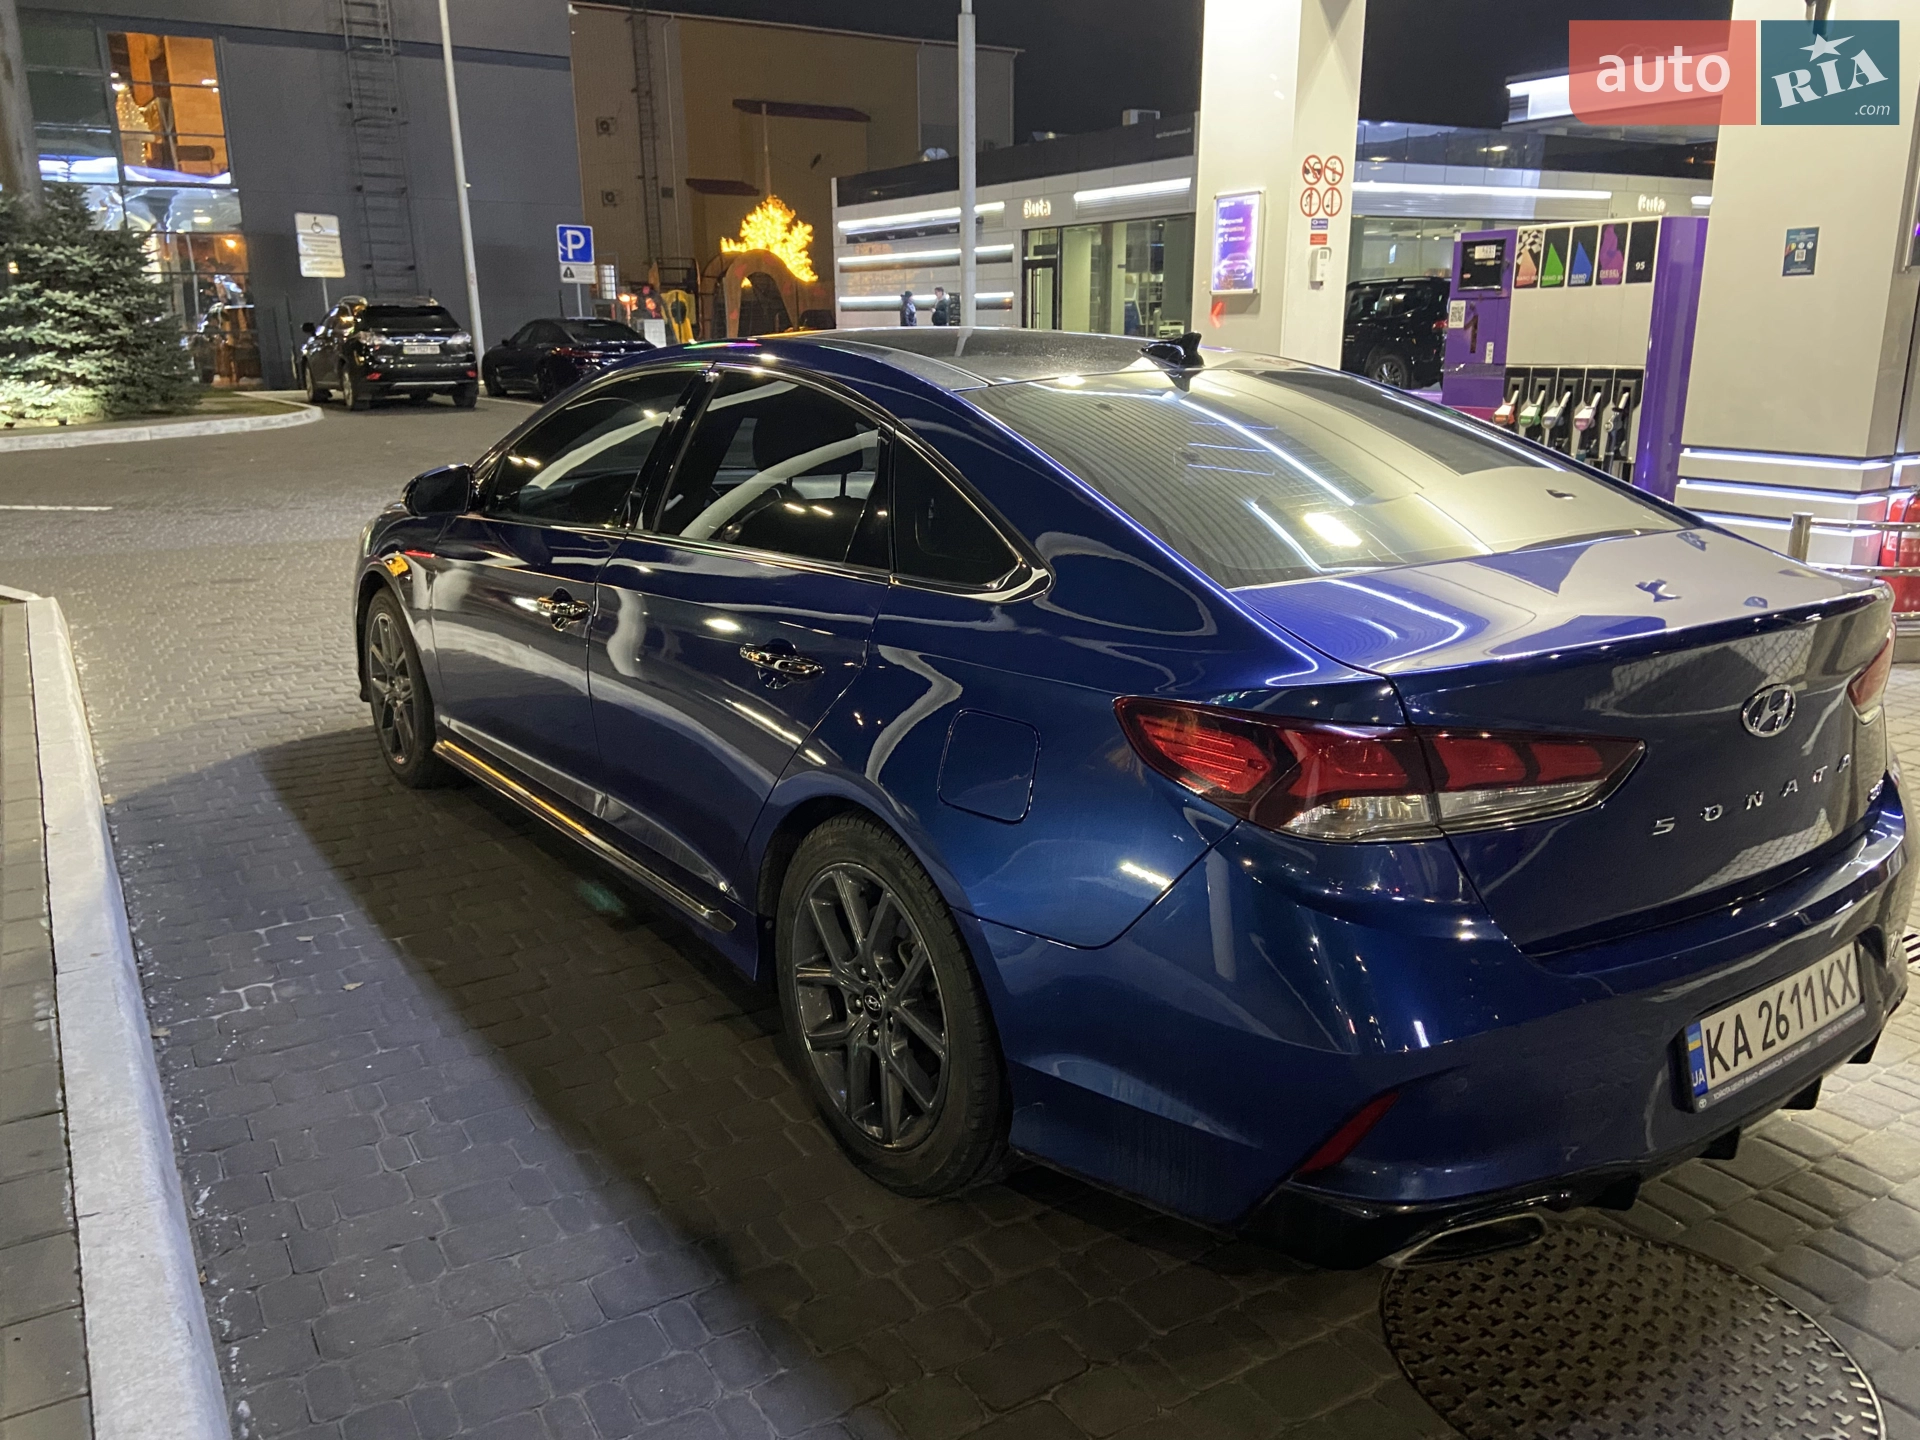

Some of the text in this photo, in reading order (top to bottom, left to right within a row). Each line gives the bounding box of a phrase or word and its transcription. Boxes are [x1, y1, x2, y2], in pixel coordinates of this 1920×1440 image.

[566, 230, 585, 259] P
[1635, 262, 1645, 270] 95
[1464, 314, 1478, 353] 1
[1652, 754, 1850, 835] SONATA
[1706, 1013, 1753, 1079] KA
[1758, 975, 1817, 1051] 2611
[1820, 953, 1857, 1016] KX
[1692, 1068, 1706, 1087] UA
